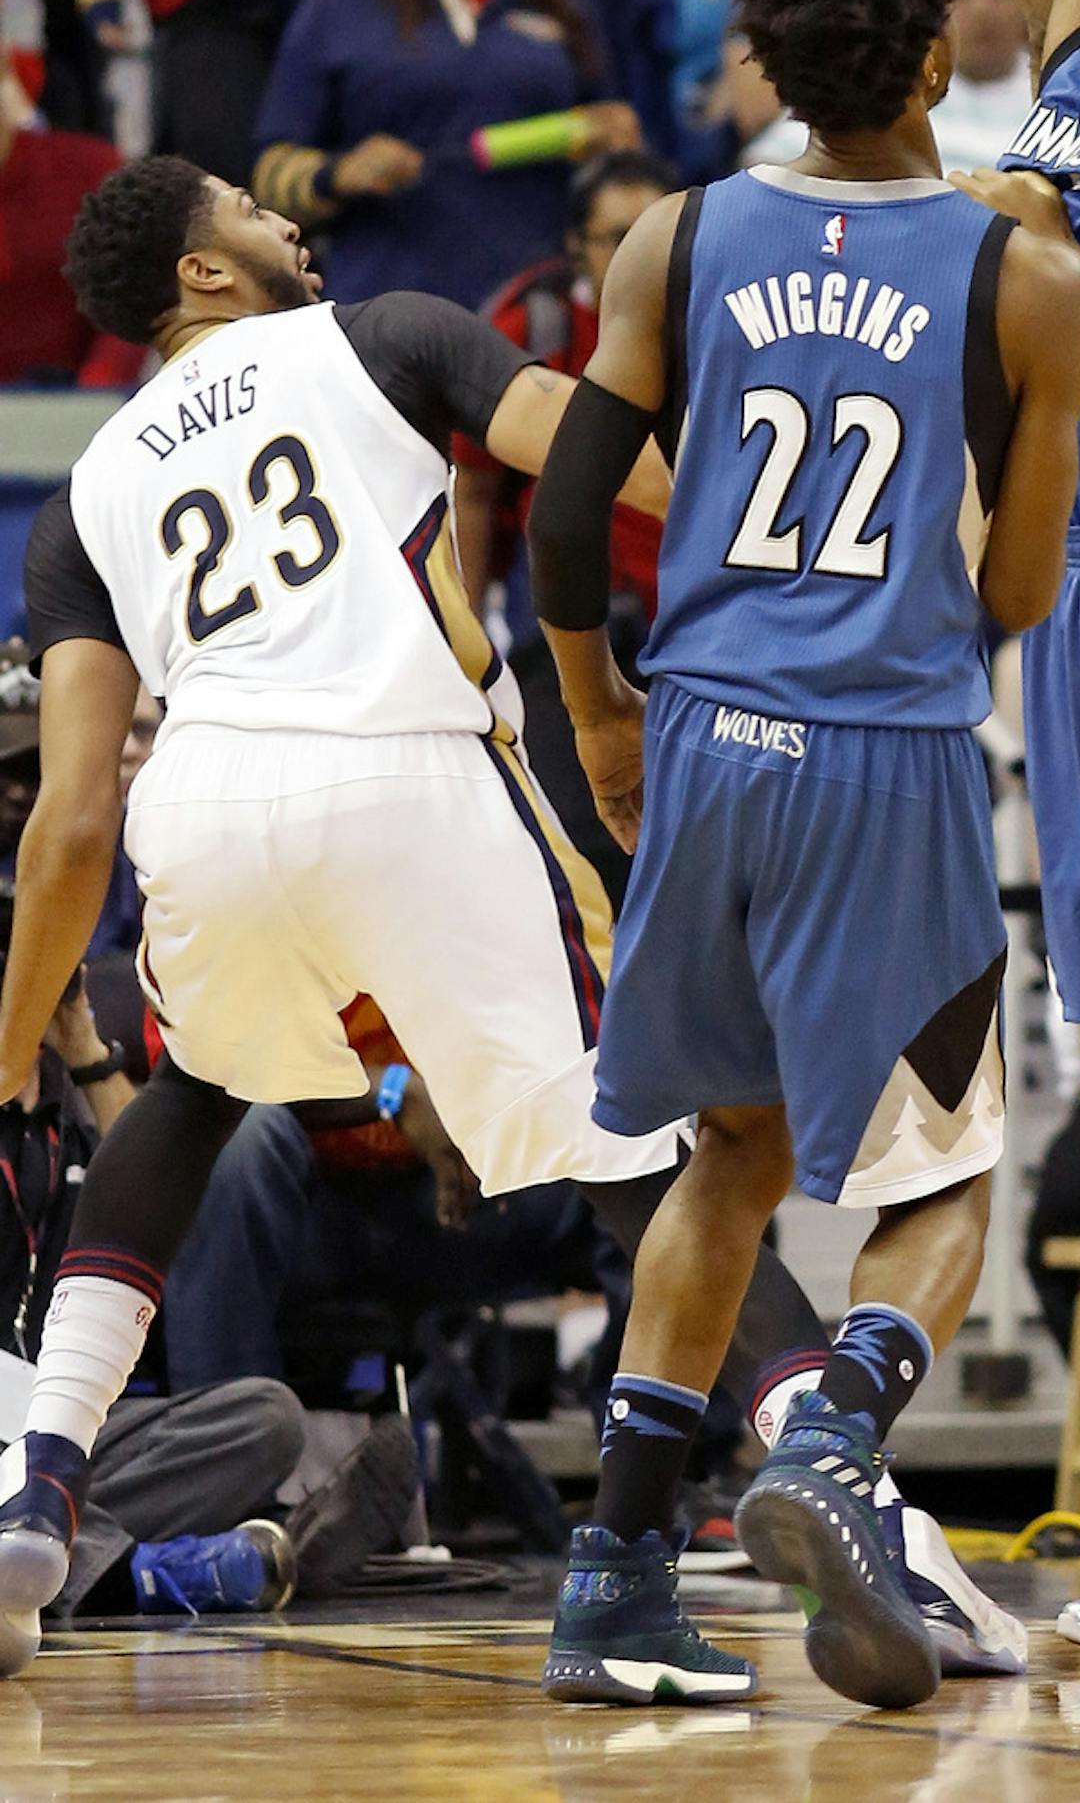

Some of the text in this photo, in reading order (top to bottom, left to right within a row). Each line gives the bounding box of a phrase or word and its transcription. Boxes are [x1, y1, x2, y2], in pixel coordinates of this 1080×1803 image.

[723, 270, 931, 364] WIGGINS
[136, 362, 258, 462] DAVIS
[721, 385, 905, 582] 22
[159, 432, 343, 646] 23
[712, 705, 806, 759] WOLVES
